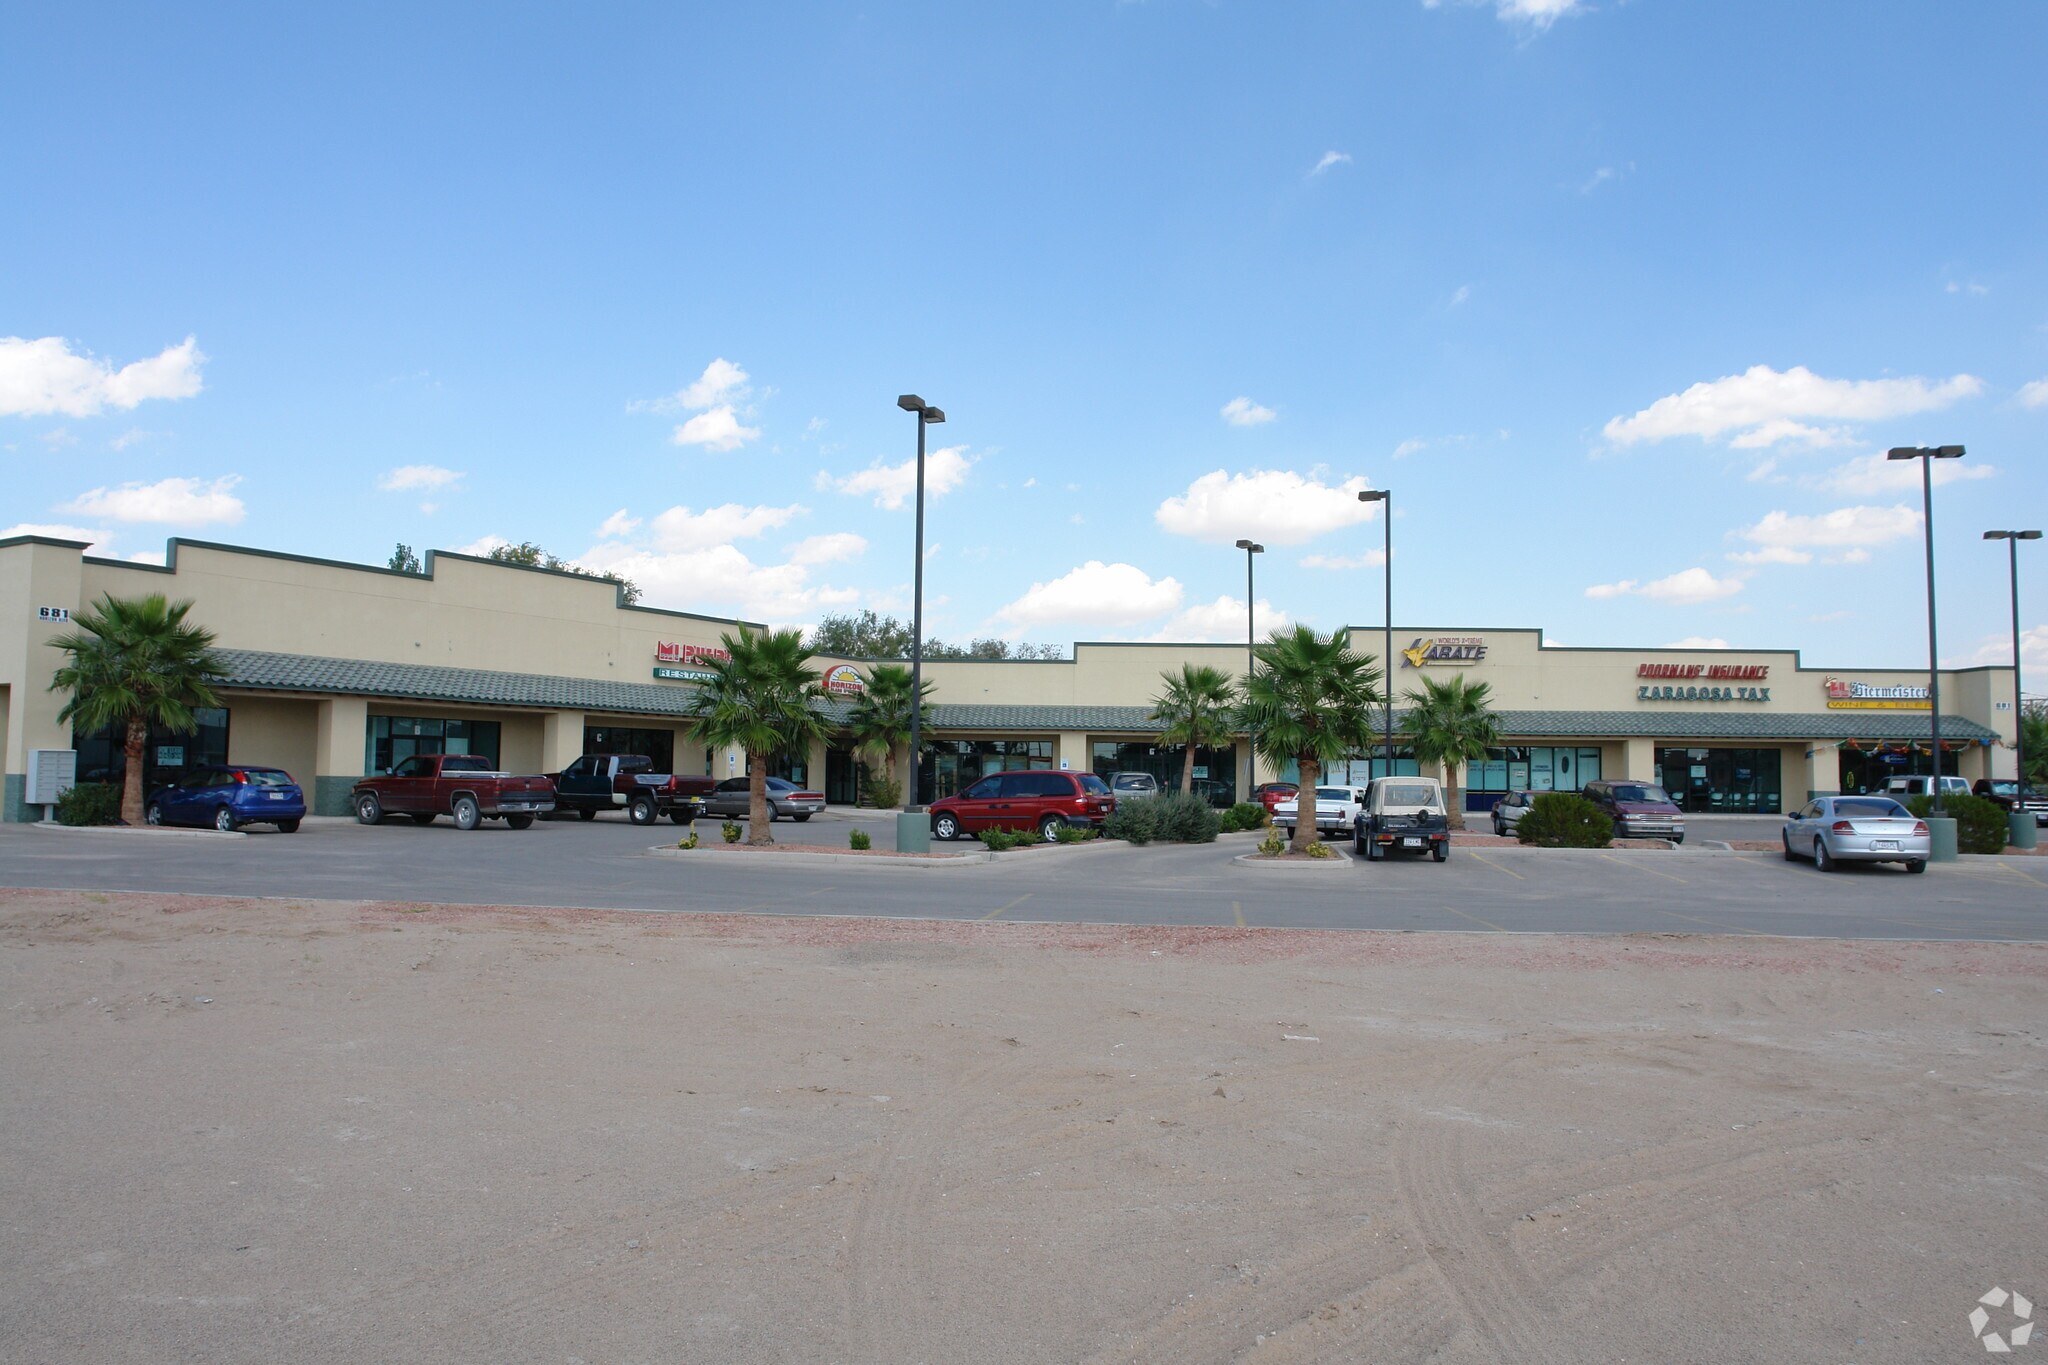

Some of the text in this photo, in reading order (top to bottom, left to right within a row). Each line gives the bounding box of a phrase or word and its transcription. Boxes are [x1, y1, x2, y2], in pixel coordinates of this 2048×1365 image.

[40, 607, 69, 618] 681
[658, 641, 680, 662] MI
[1706, 664, 1770, 680] INSURANCE
[830, 681, 863, 691] HORIZON
[1638, 686, 1771, 702] ZARAGOSA TAX
[1850, 681, 1928, 699] Biermeister
